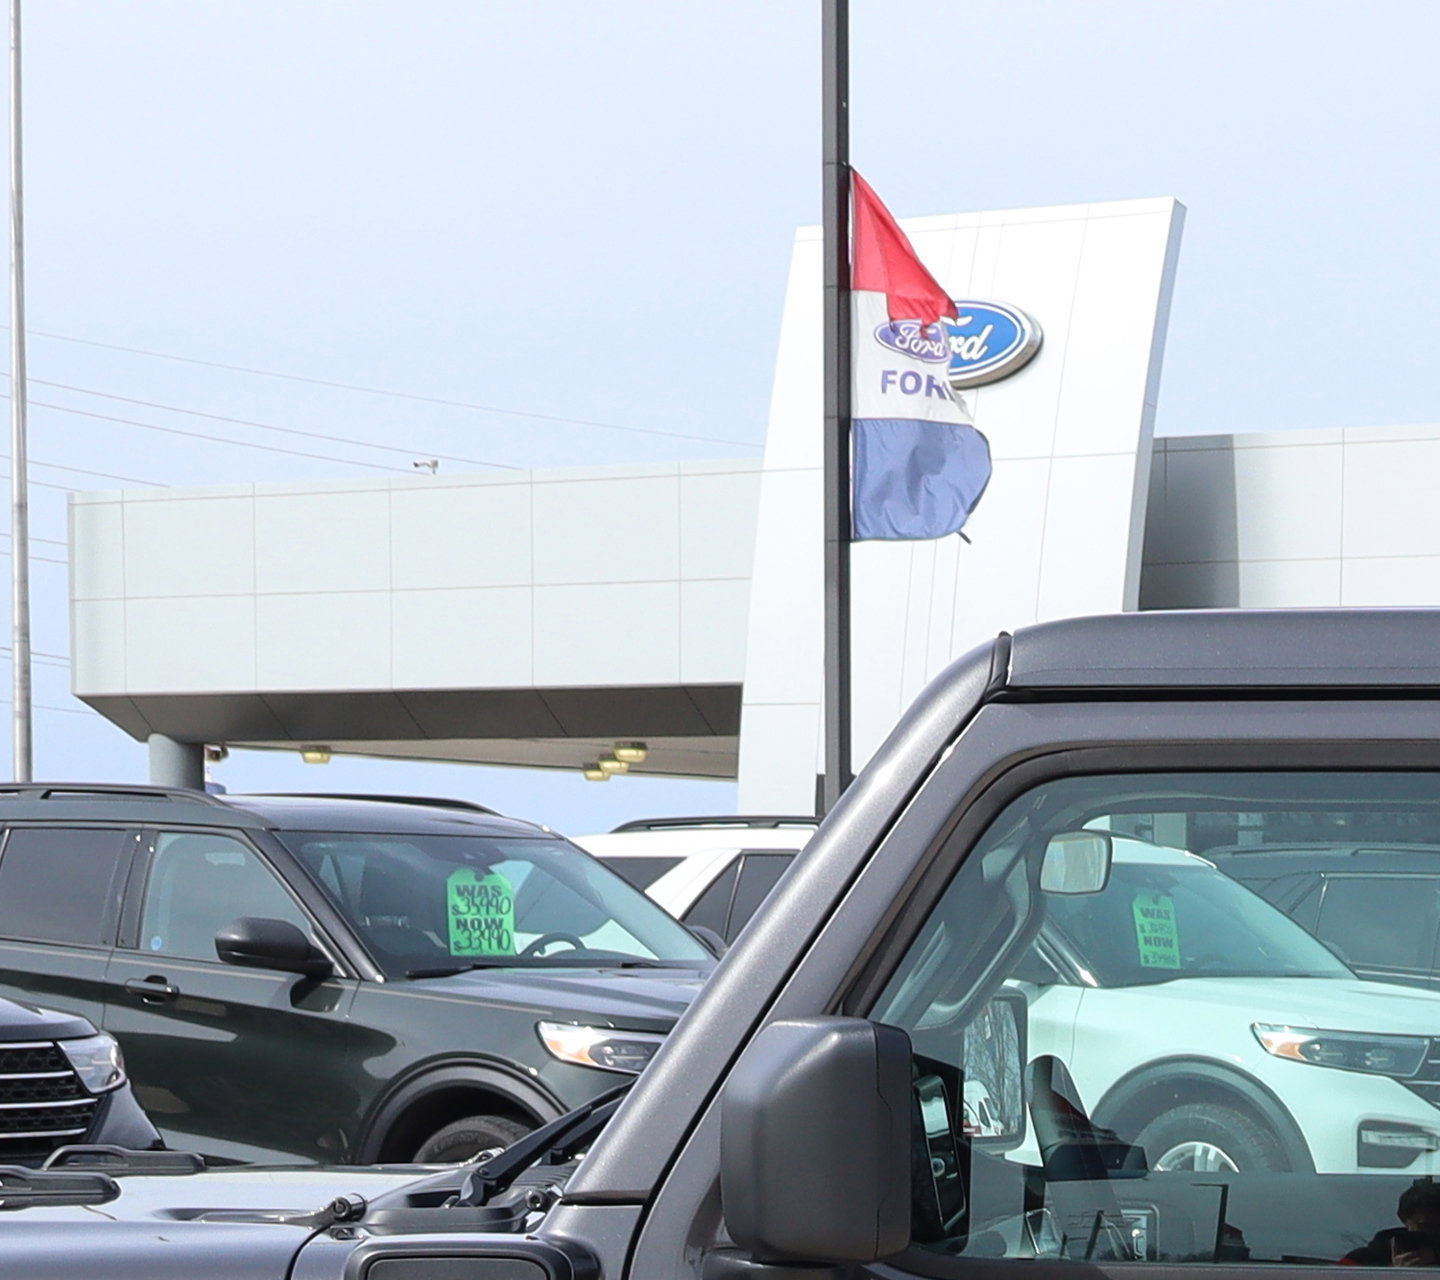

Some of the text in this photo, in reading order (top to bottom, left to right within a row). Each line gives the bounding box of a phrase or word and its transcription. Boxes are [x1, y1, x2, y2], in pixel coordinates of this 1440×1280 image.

[880, 369, 950, 401] FOR
[455, 885, 502, 897] WAS
[455, 917, 504, 931] NOW
[1143, 935, 1173, 948] NOW
